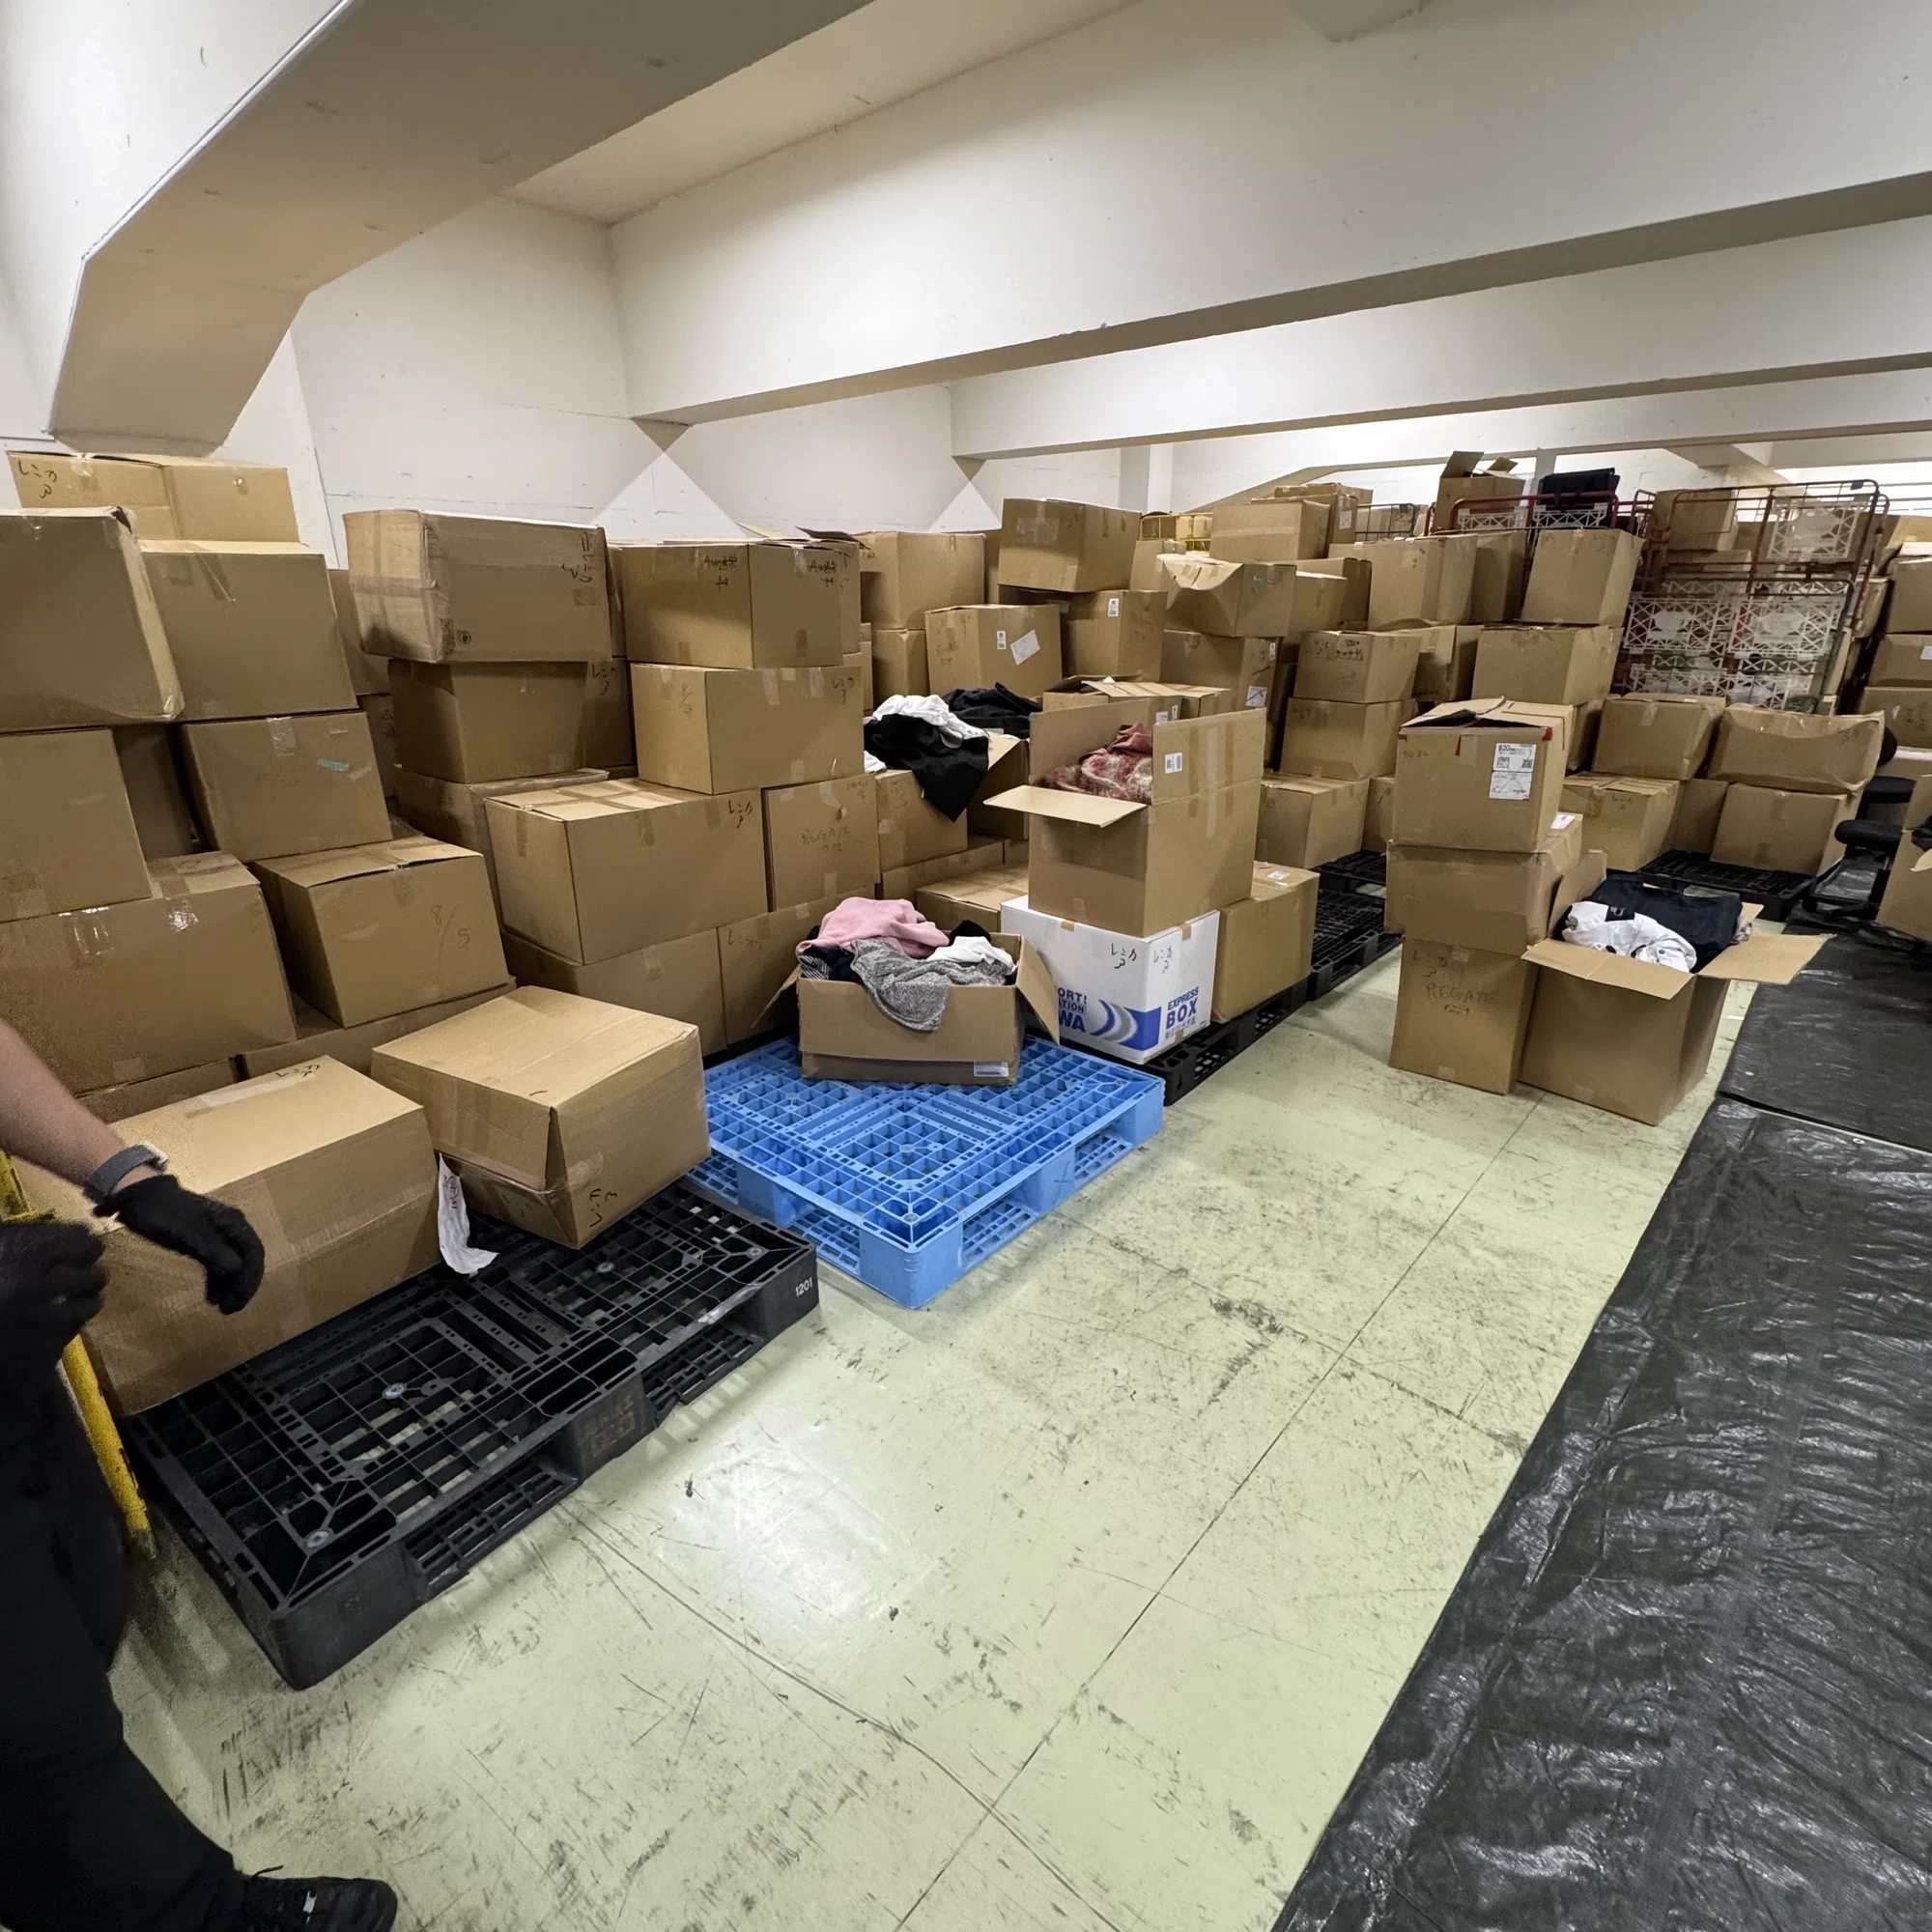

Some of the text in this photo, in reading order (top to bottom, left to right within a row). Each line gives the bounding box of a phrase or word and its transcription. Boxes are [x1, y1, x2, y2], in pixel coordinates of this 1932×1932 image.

[1167, 986, 1199, 1010] EXPRESS
[1166, 997, 1199, 1030] BOX
[795, 1277, 813, 1297] 1201
